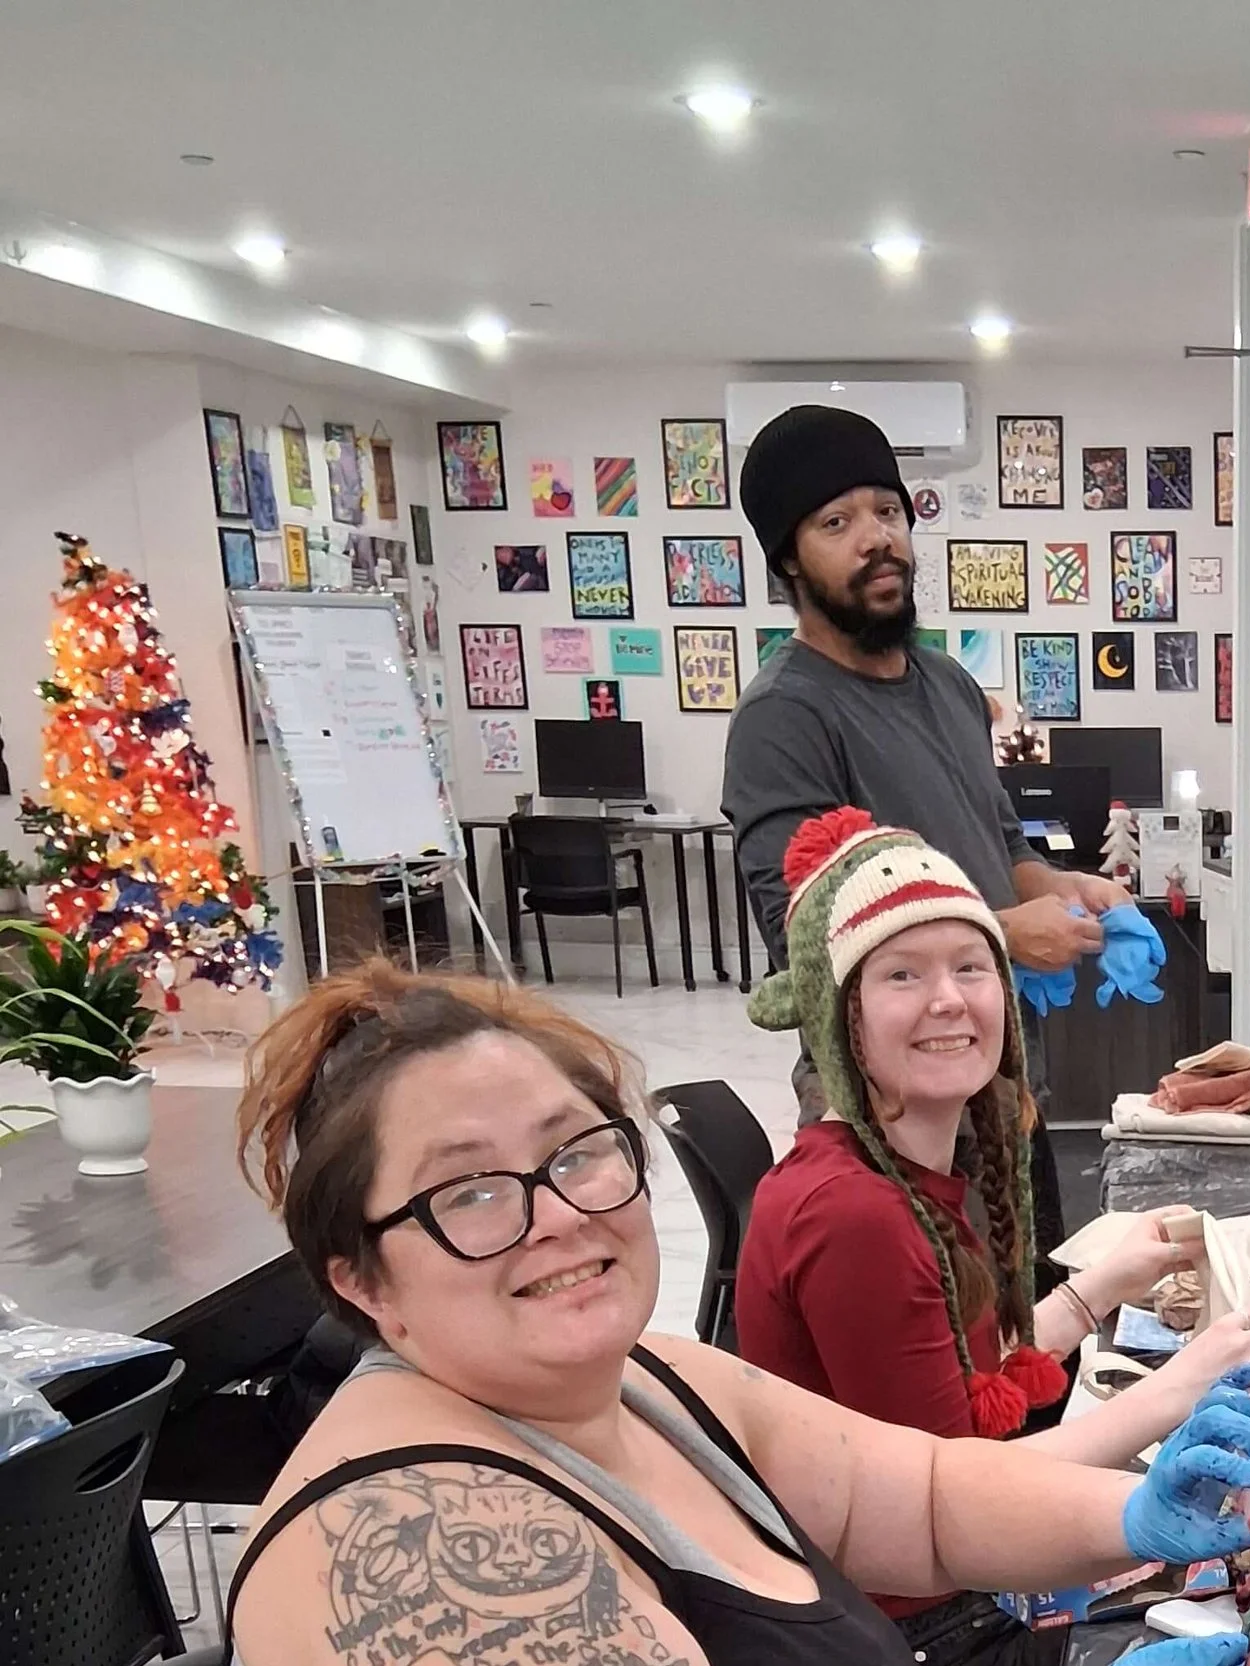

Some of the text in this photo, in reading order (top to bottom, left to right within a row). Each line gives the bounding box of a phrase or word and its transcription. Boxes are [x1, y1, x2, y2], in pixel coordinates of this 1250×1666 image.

[1013, 487, 1047, 504] ME
[956, 562, 1025, 587] SPIRITUAL
[577, 586, 630, 604] NEVER
[680, 632, 732, 652] NEVER
[1022, 639, 1073, 660] BE KIND
[682, 655, 732, 678] GIVE
[1024, 669, 1075, 689] RESPECT
[687, 683, 726, 704] UP
